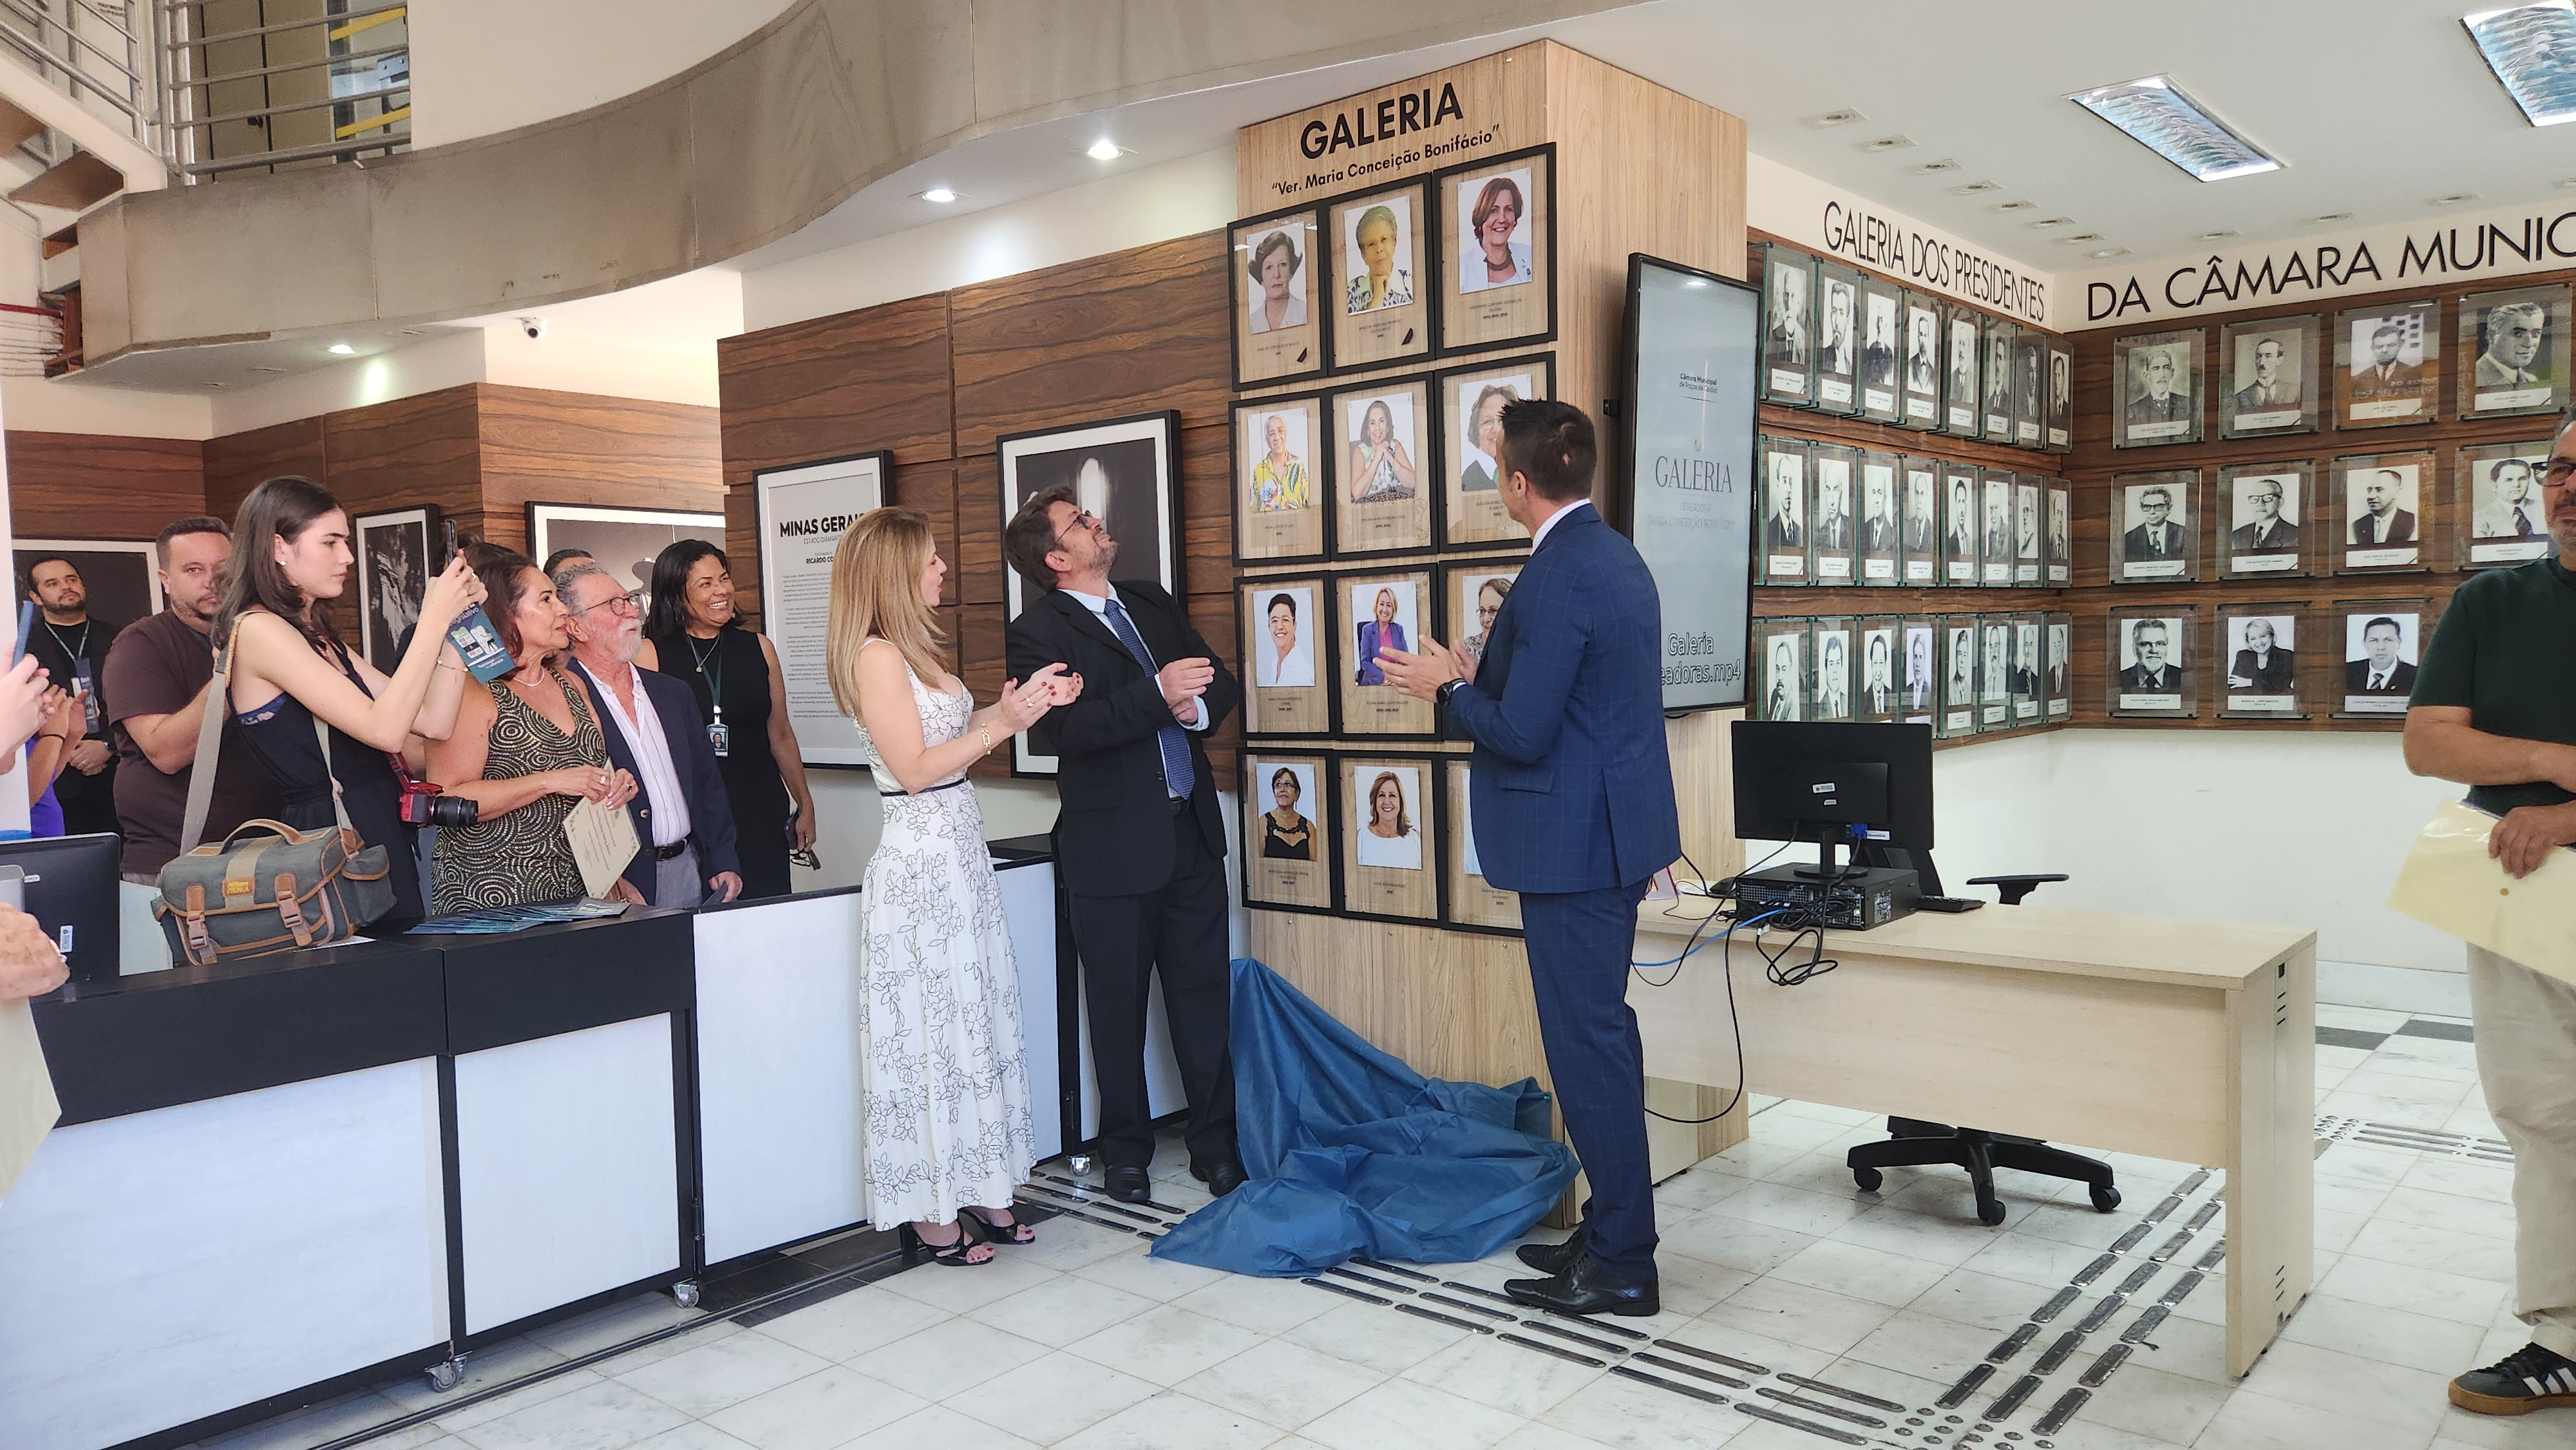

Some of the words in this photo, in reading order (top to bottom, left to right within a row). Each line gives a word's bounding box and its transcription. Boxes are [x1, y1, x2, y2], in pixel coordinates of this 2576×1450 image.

[1300, 82, 1464, 159] GALERIA
[1305, 169, 1343, 189] Maria
[1348, 150, 1421, 177] Conceição
[1824, 201, 1906, 274] GALERIA
[1912, 232, 1949, 287] DOS
[1955, 249, 2044, 323] PRESIDENTES
[2088, 276, 2151, 321] DA
[2165, 241, 2382, 308] CÂMARA
[2397, 212, 2576, 278] MUNIC
[1656, 456, 1732, 493] GALERIA
[780, 518, 819, 537] MINAS
[821, 513, 865, 533] GERA
[1668, 631, 1714, 655] Galeria
